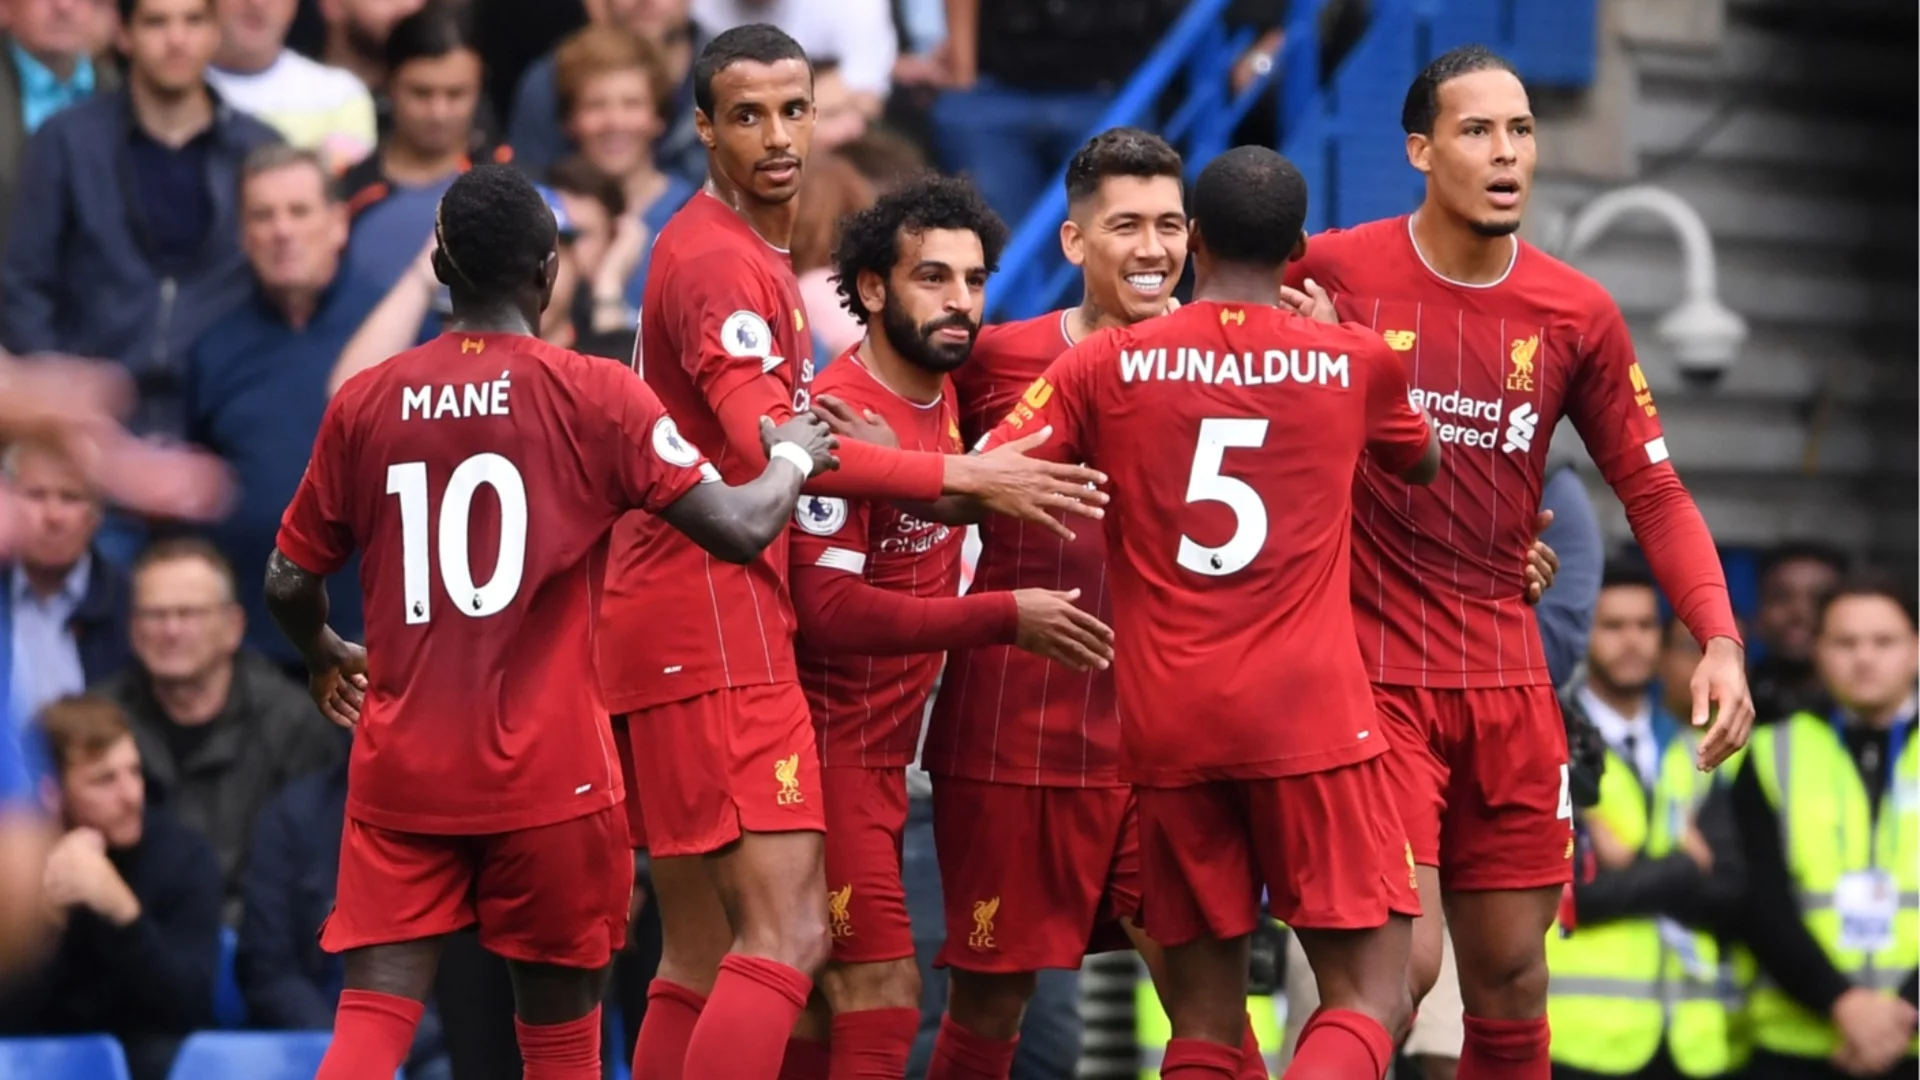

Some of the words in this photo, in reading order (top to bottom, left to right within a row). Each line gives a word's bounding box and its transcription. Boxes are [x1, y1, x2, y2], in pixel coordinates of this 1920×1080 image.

[1120, 347, 1350, 389] WIJNALDUM
[1506, 378, 1535, 392] LFC
[401, 370, 511, 421] MANÉ
[1176, 417, 1269, 577] 5
[386, 452, 528, 624] 10
[777, 791, 804, 805] LFC
[968, 936, 996, 948] LFC
